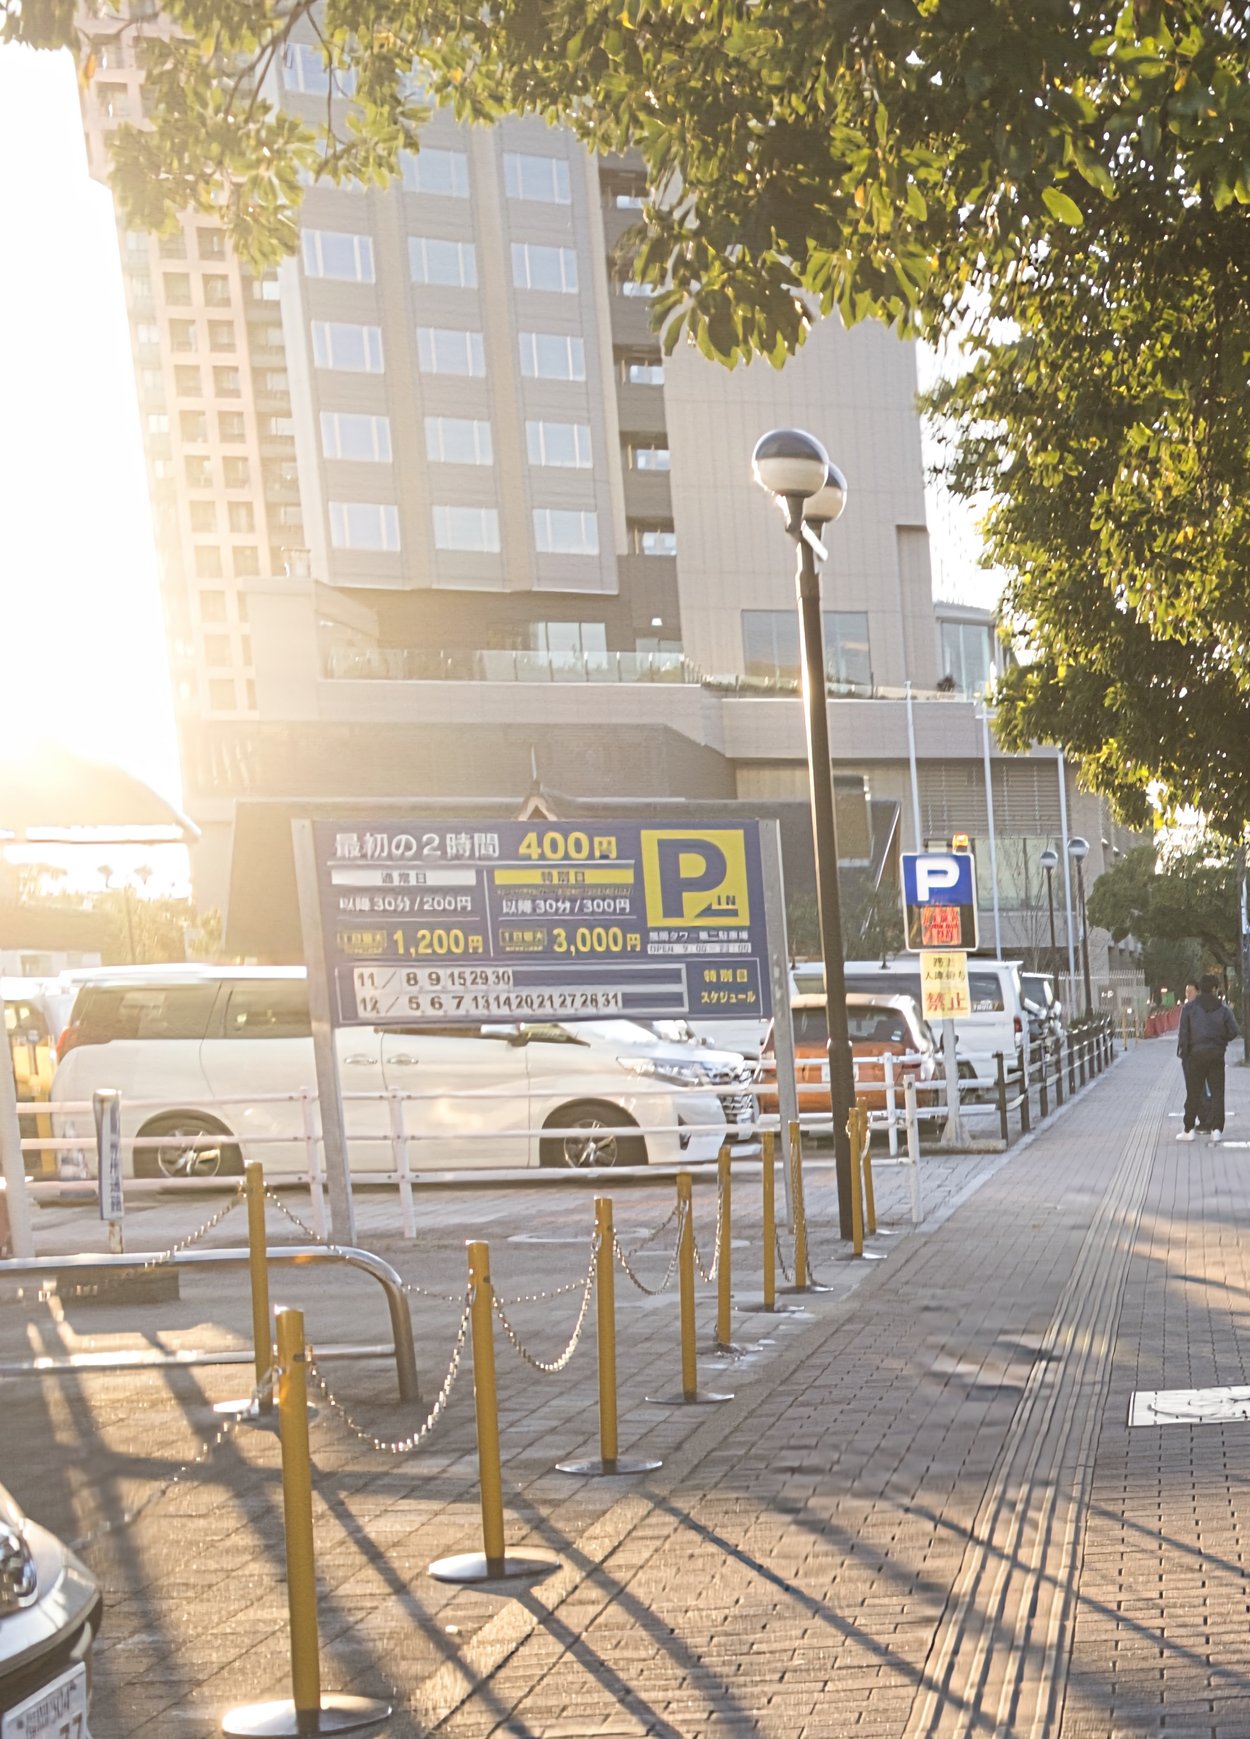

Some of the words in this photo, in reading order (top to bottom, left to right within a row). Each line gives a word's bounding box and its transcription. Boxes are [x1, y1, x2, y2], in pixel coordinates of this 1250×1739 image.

[518, 831, 617, 860] 400円
[657, 838, 728, 919] P
[916, 856, 960, 901] P
[701, 991, 756, 1004] スケジュール
